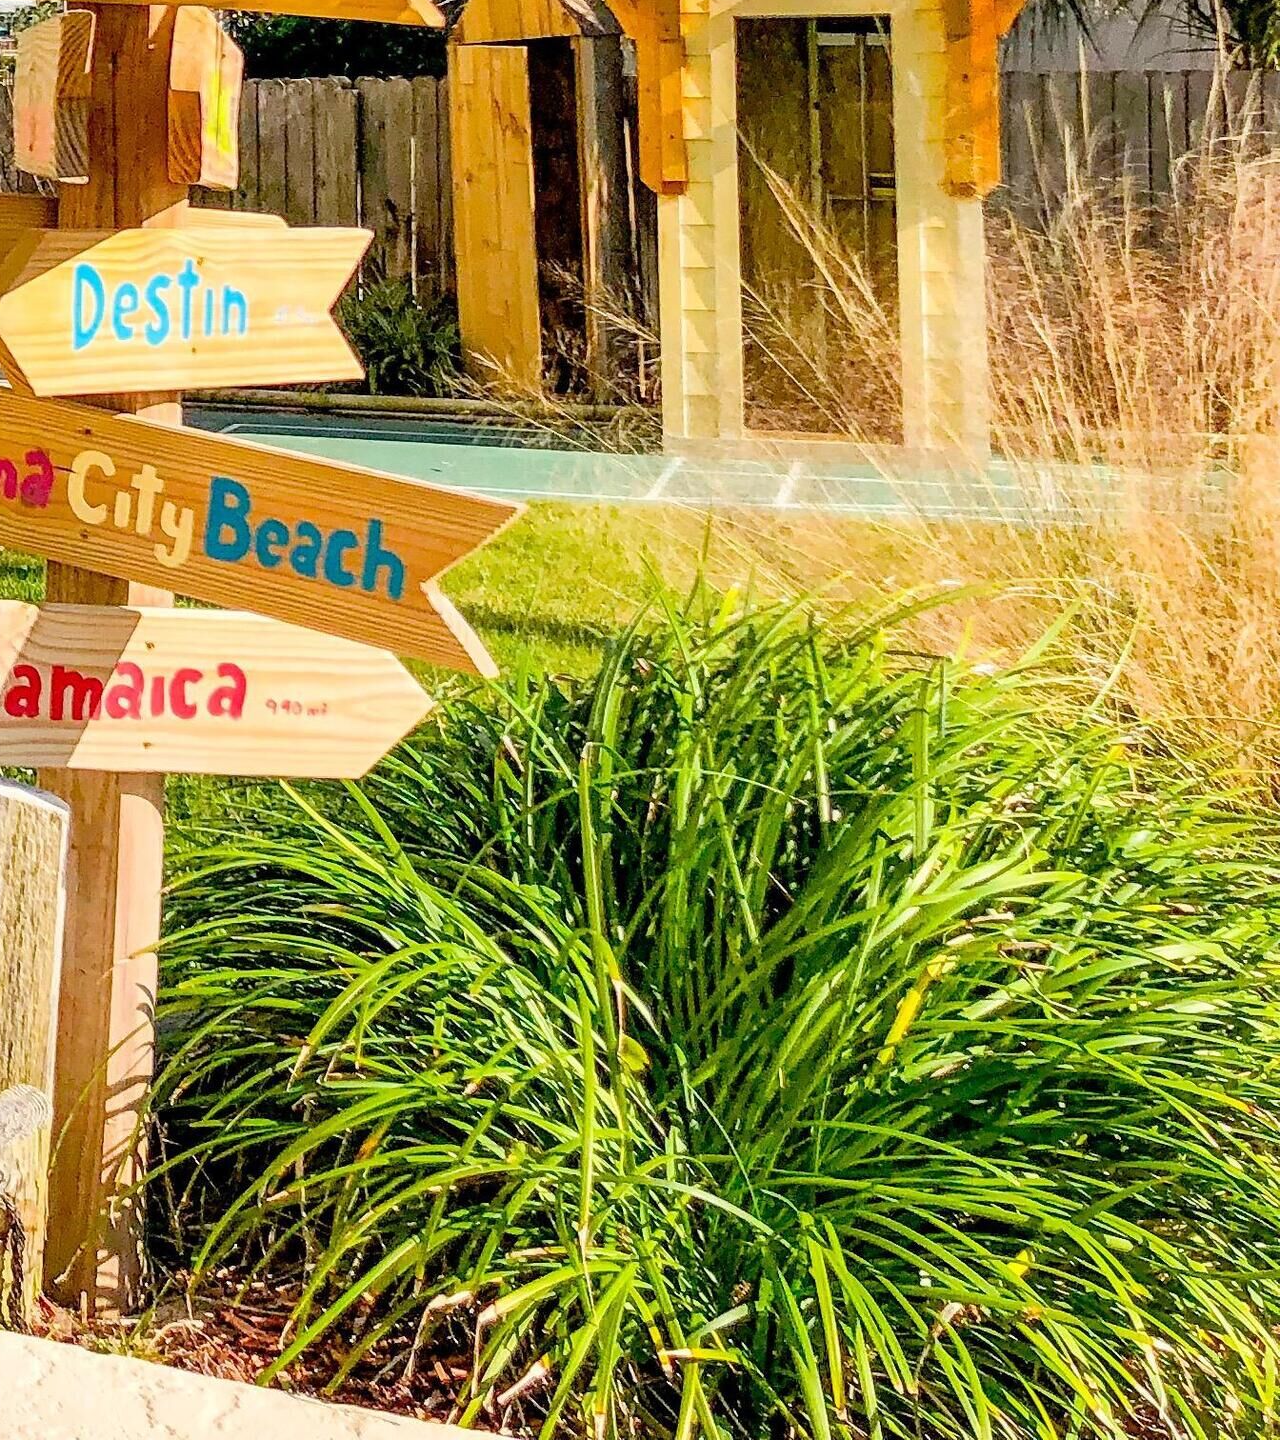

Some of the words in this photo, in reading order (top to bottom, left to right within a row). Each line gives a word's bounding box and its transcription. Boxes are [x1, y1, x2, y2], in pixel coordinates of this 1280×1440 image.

[71, 258, 248, 351] Destin
[67, 449, 194, 568] City
[204, 474, 405, 601] Beach
